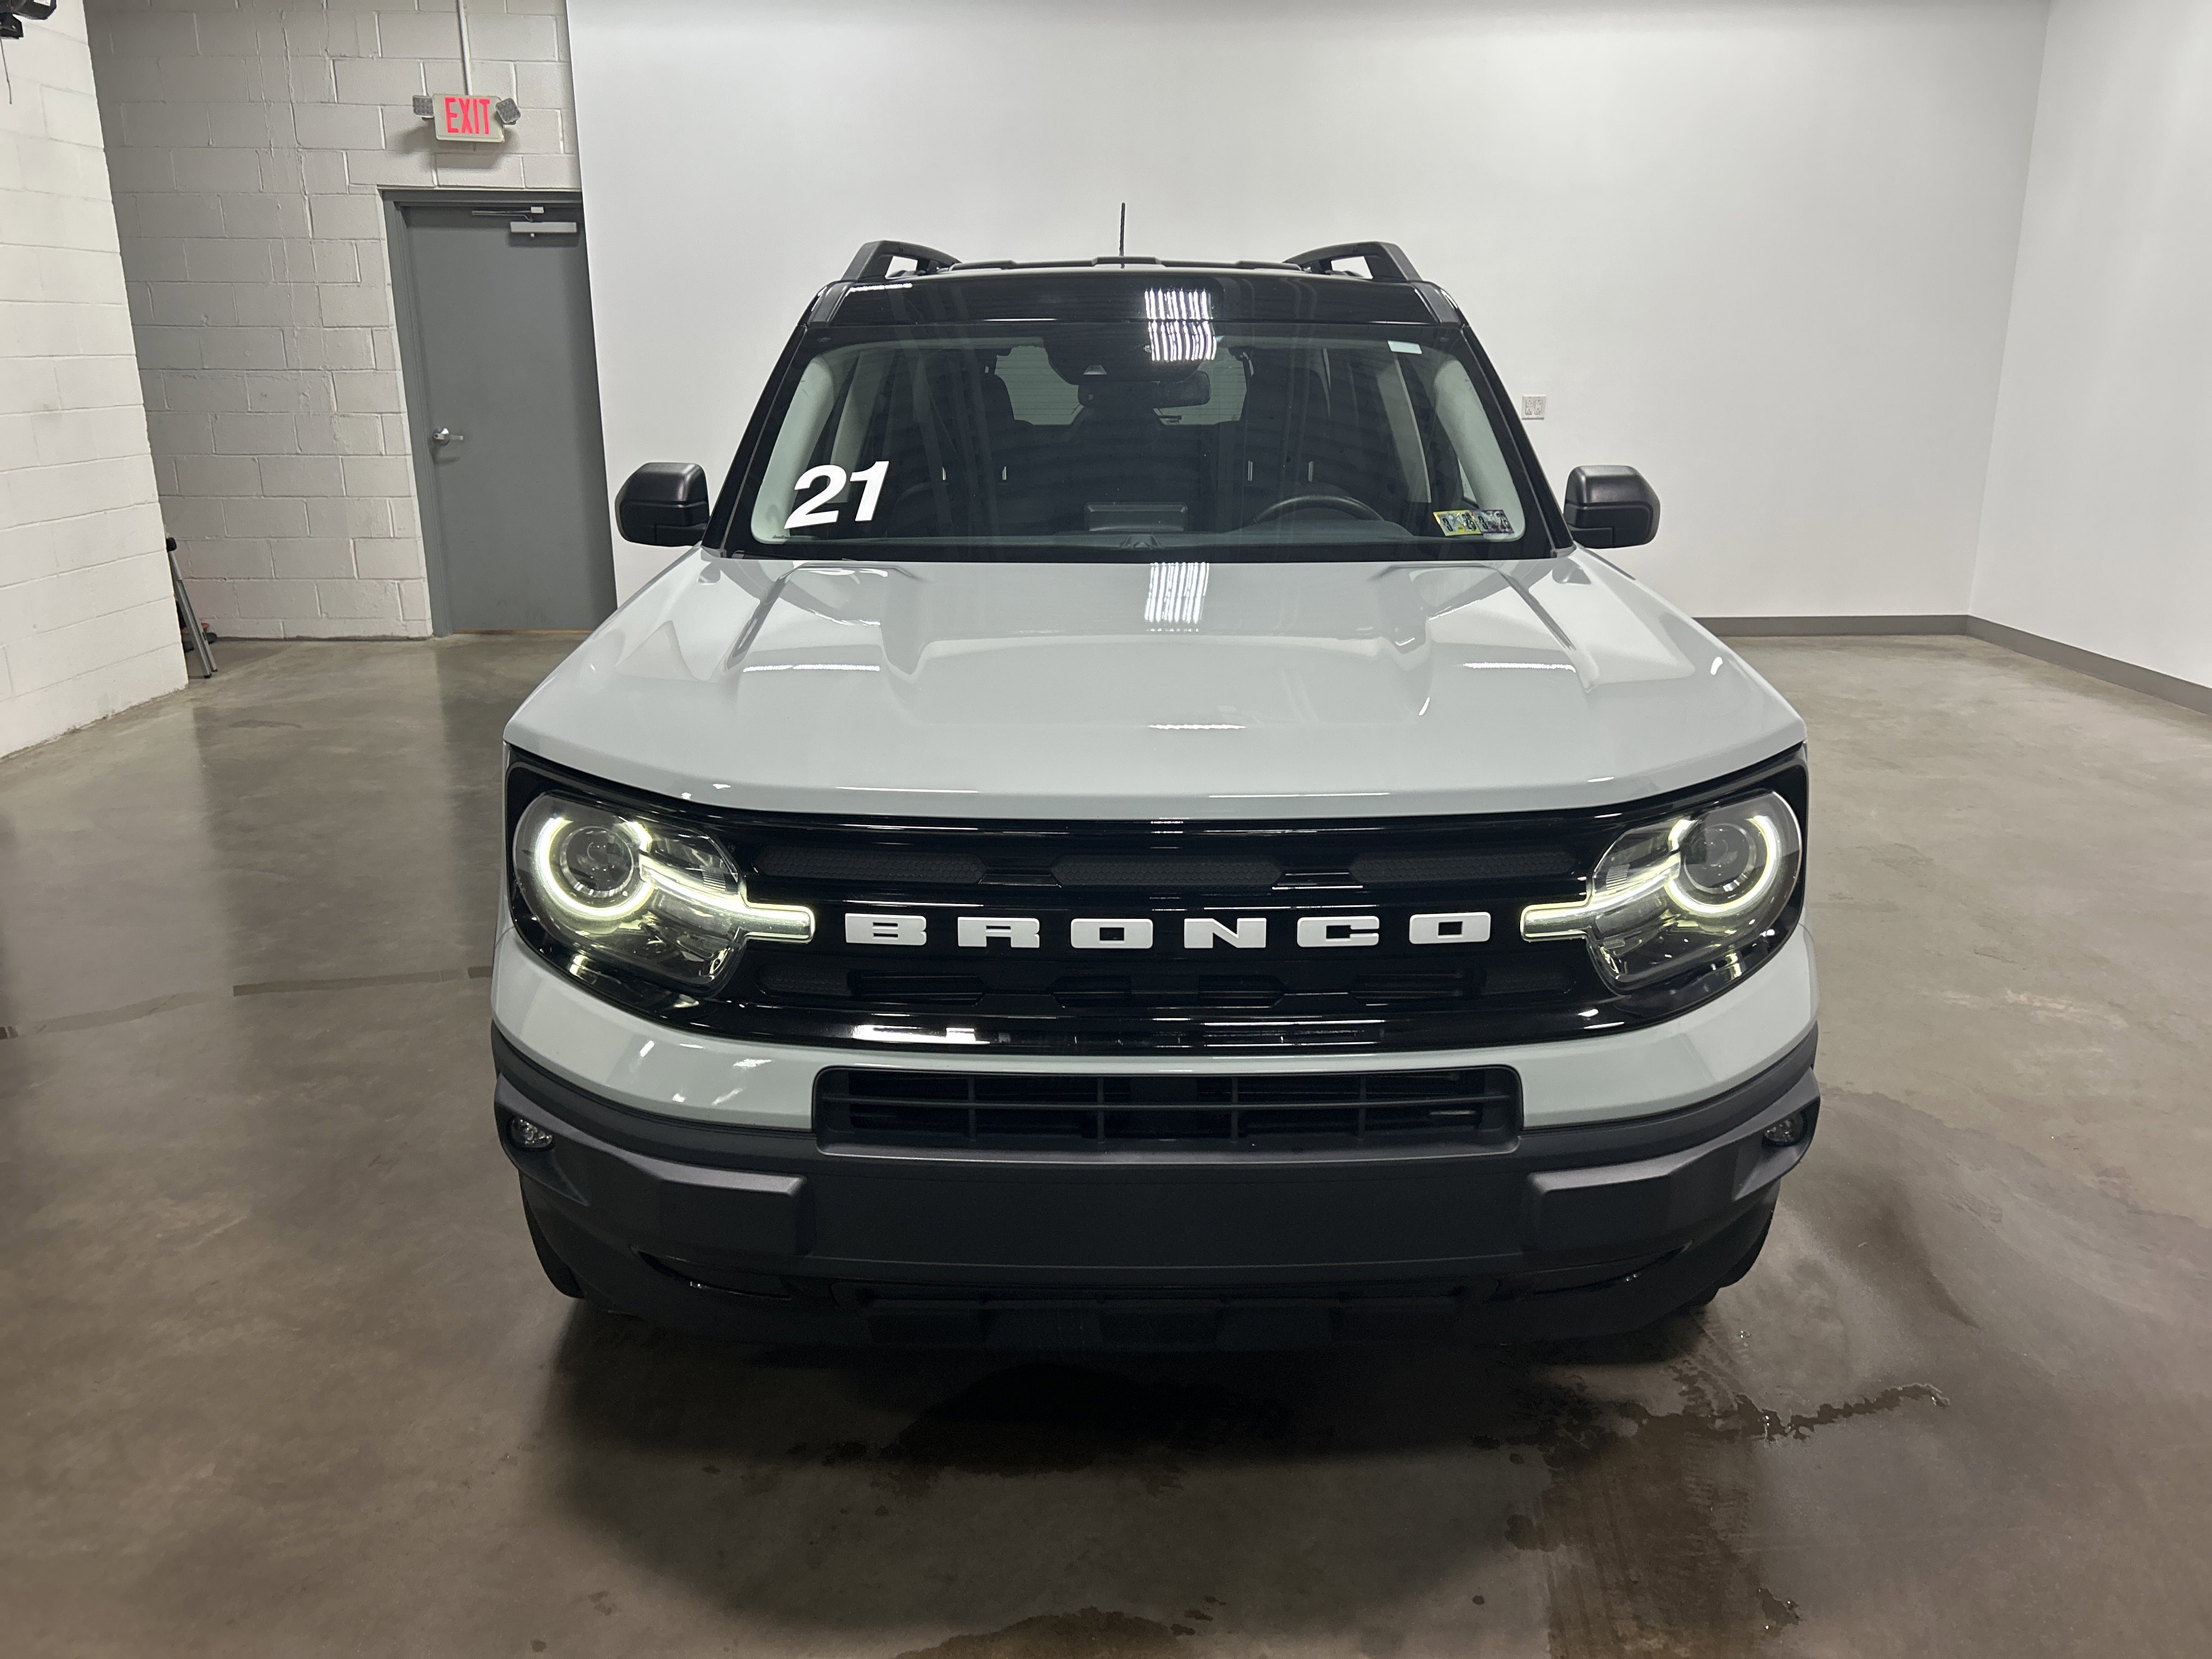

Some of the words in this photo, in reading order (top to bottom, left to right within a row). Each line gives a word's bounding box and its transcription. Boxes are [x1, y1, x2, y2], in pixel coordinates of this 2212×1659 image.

[444, 97, 491, 135] EXIT
[784, 461, 889, 529] 21
[845, 912, 1491, 950] BRONCO
